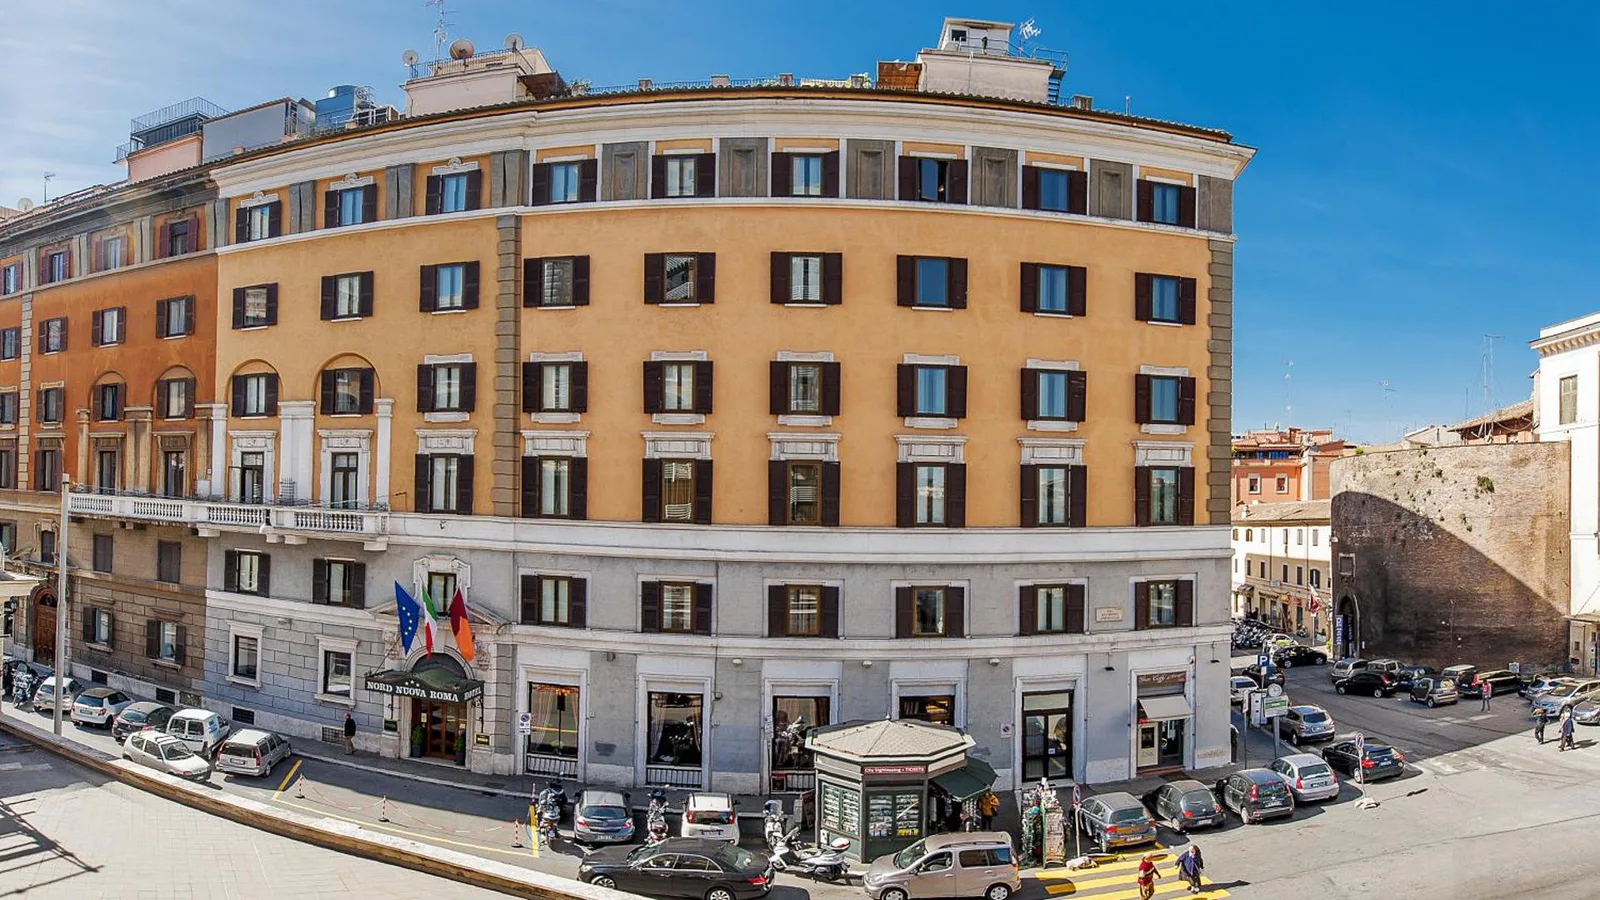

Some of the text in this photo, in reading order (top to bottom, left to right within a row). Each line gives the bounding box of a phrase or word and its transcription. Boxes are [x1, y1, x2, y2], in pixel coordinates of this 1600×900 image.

[1259, 655, 1268, 666] P
[366, 681, 482, 703] NORD NUOVA ROMA HOTEL
